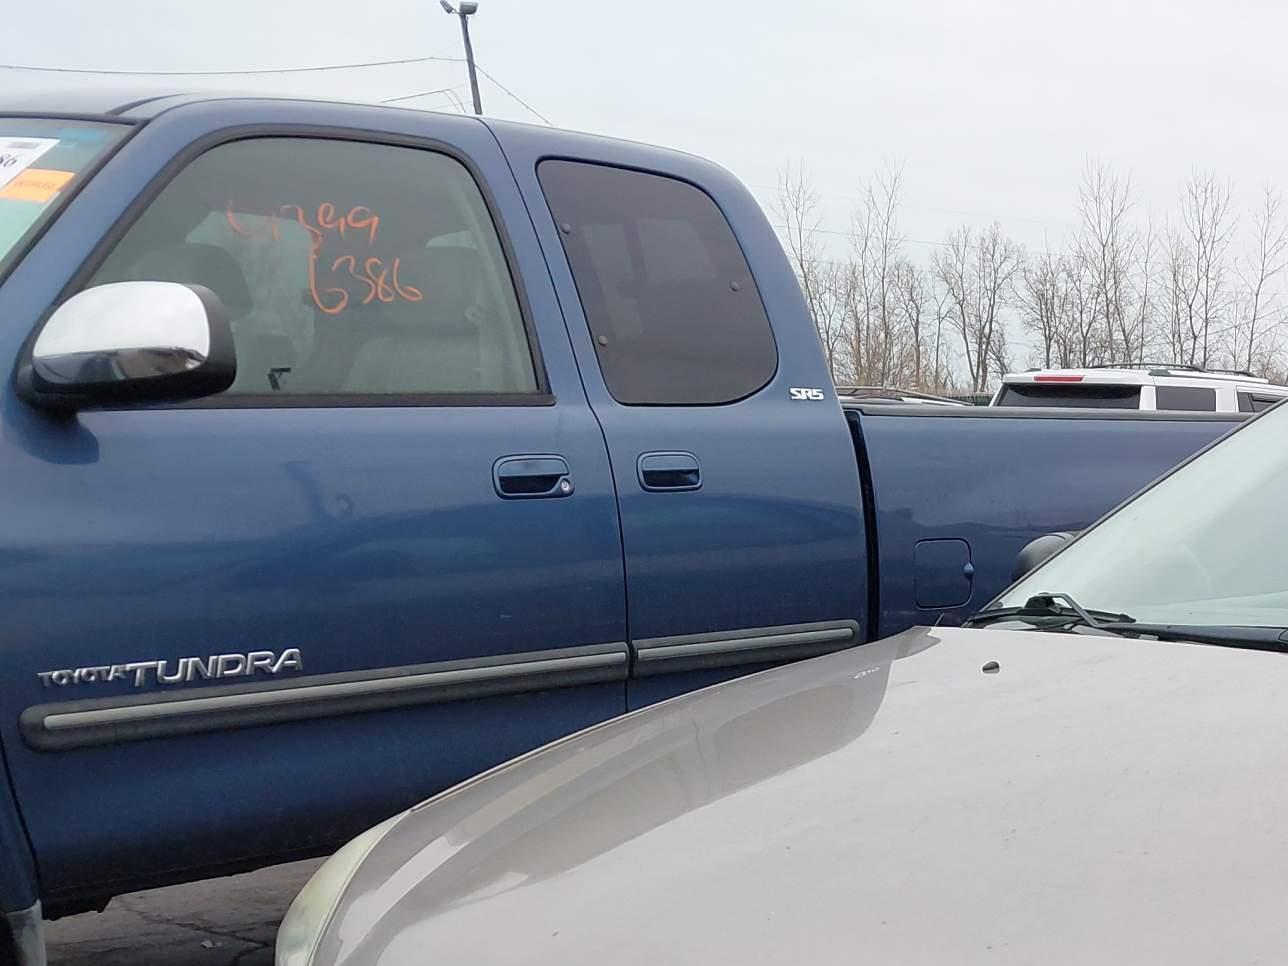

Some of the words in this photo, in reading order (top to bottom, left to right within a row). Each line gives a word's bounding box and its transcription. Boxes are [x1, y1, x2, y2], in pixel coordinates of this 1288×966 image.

[790, 387, 824, 400] SR5
[37, 664, 130, 688] TOYOTA
[124, 648, 303, 688] TUNDRA
